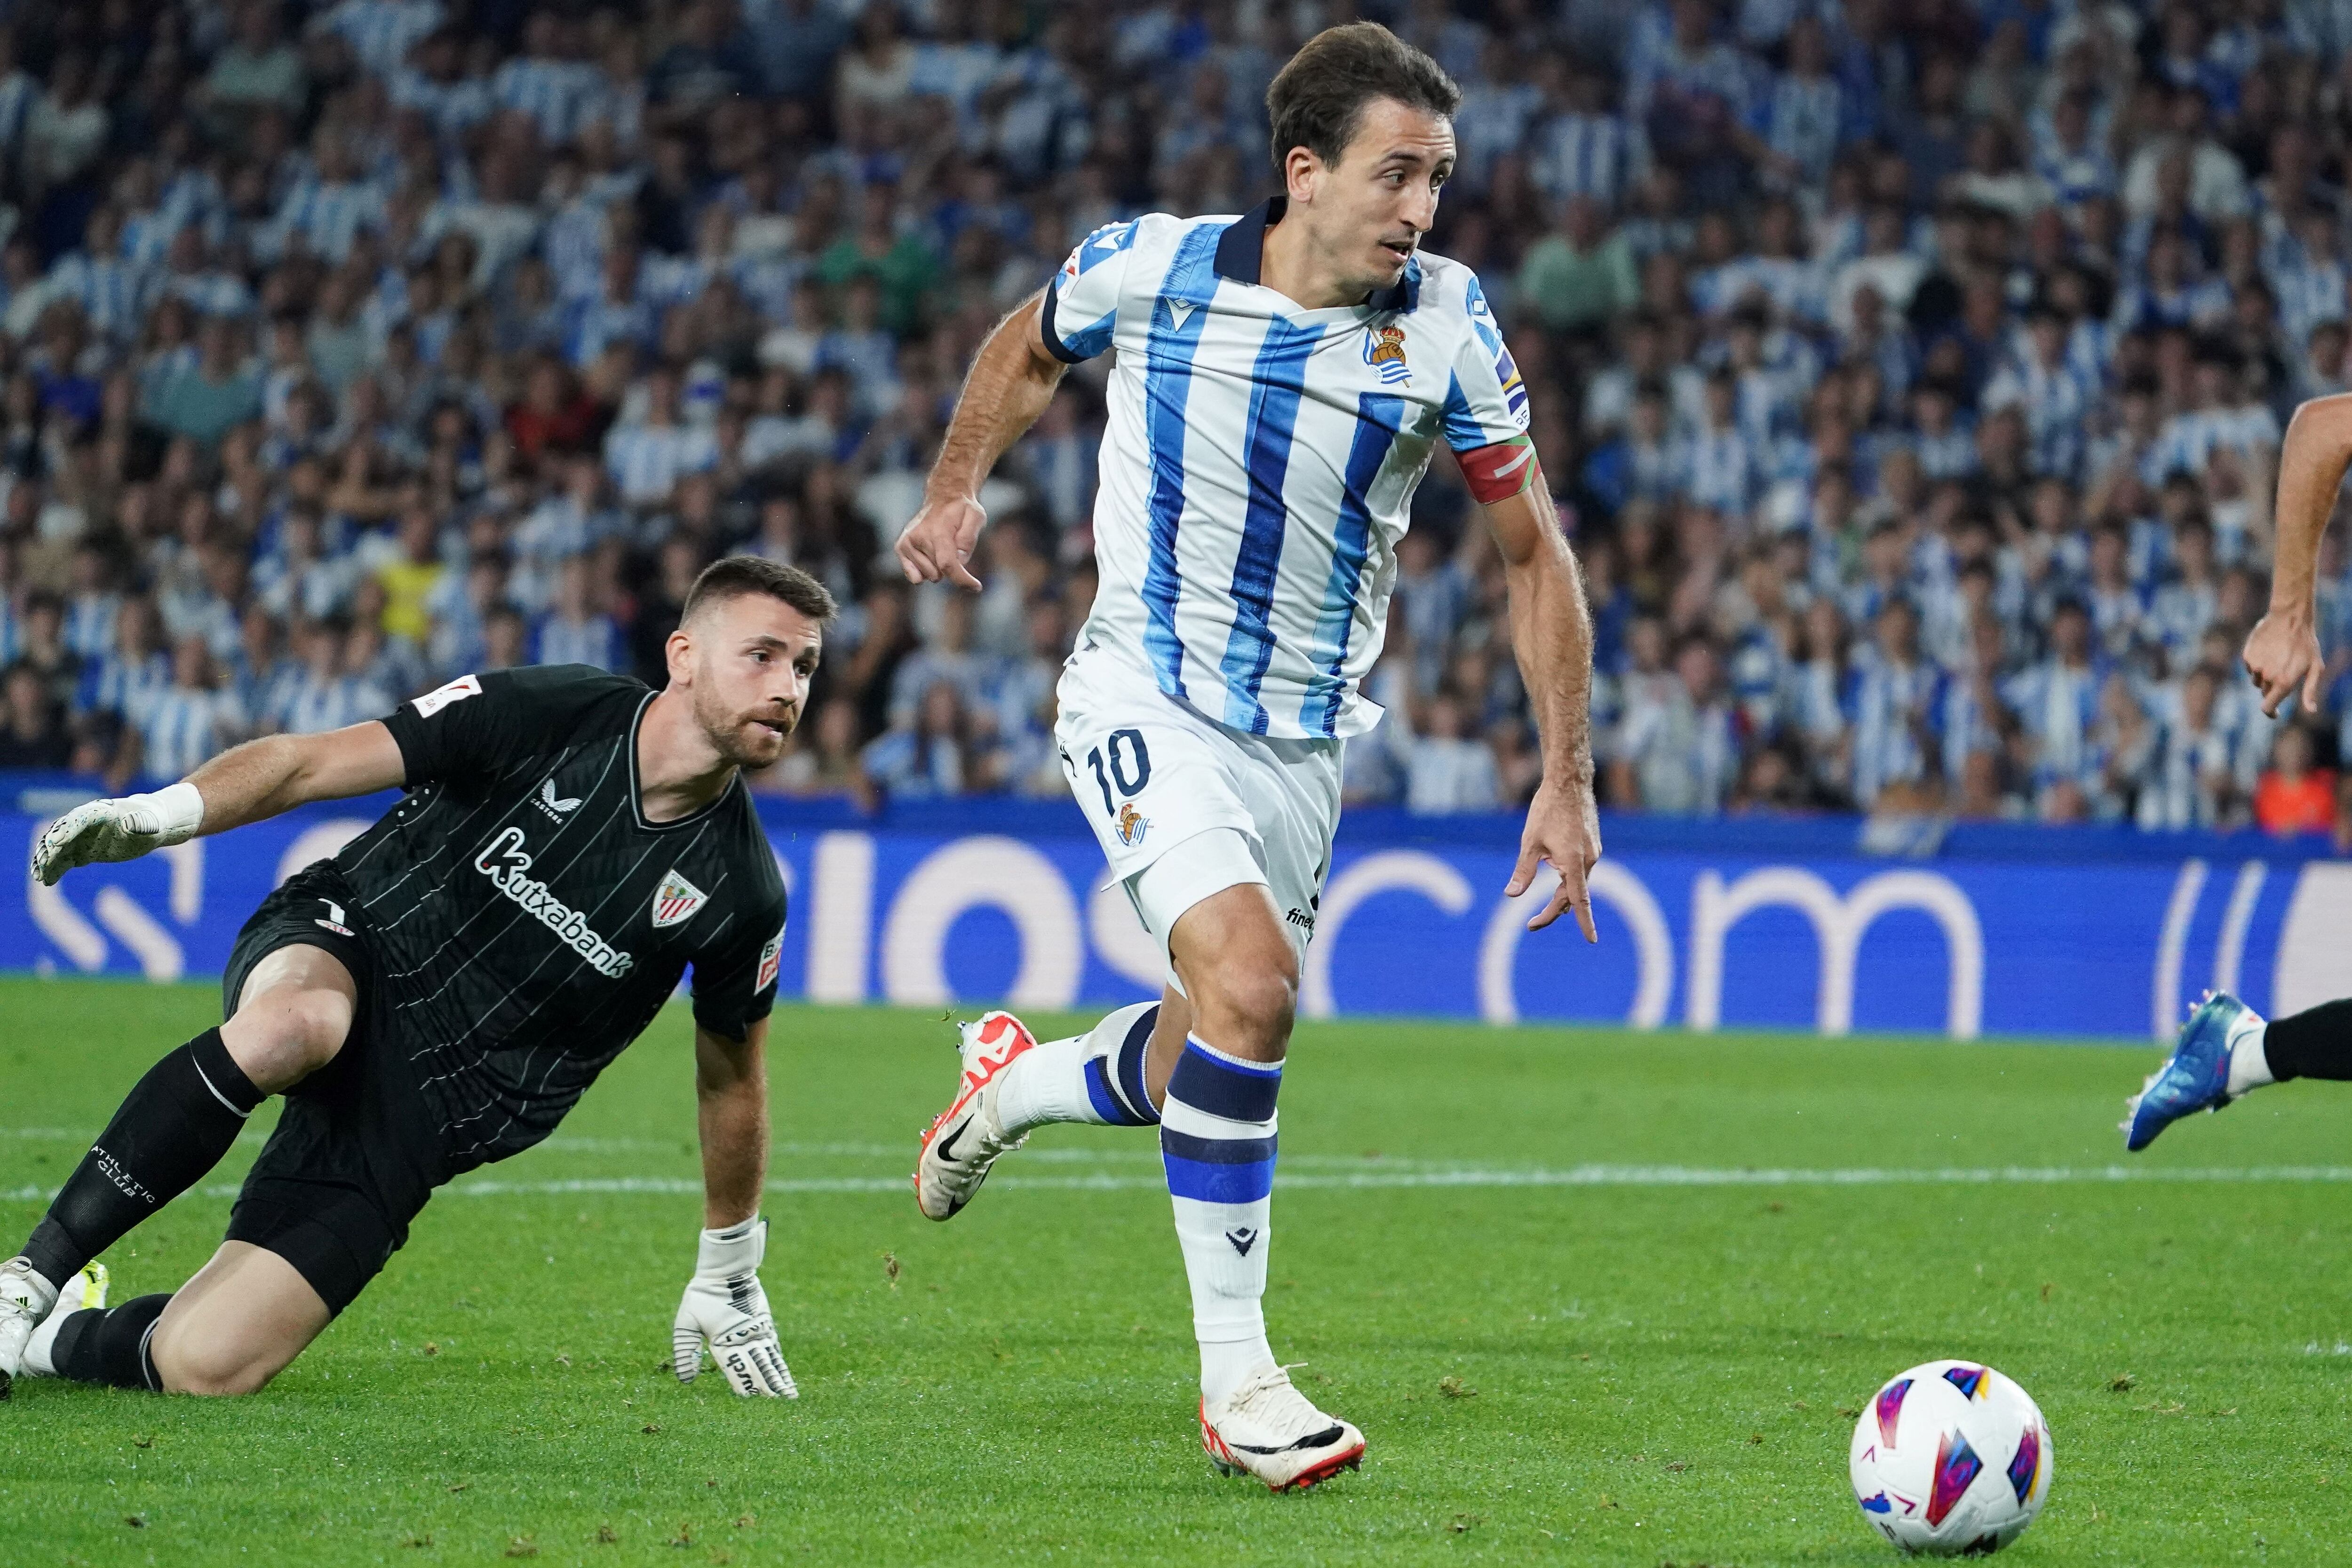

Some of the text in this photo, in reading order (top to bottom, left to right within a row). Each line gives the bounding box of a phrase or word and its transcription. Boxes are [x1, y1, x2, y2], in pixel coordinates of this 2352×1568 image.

[1088, 729, 1151, 818] 10
[475, 827, 634, 978] Kutxabank
[1286, 908, 1315, 930] finet
[91, 1145, 156, 1203] ATHLETIC
[97, 1160, 136, 1198] CLUB
